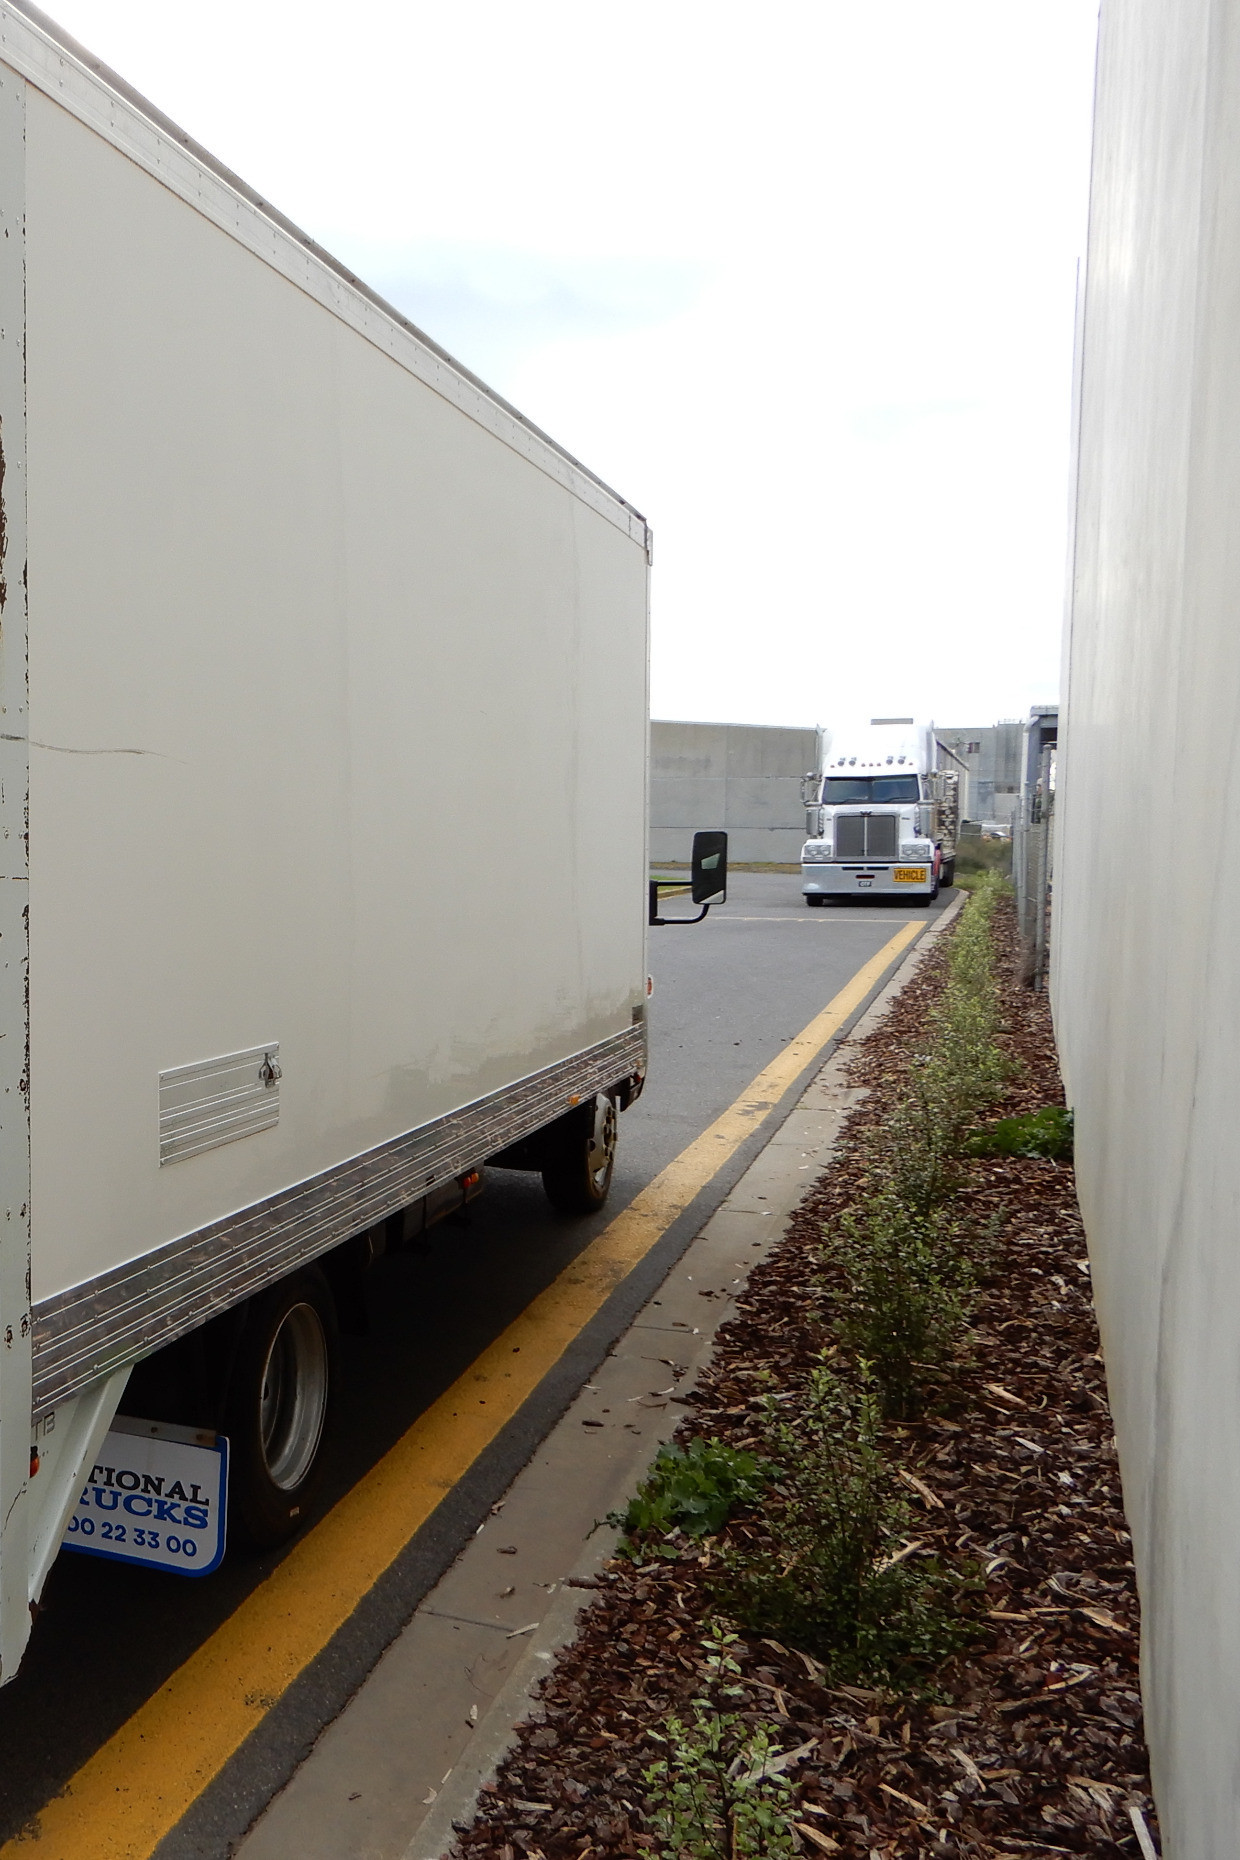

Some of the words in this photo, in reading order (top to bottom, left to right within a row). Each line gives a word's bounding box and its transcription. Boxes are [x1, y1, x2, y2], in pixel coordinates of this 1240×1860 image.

[893, 870, 925, 881] VEHICLE
[31, 1411, 55, 1441] TB
[88, 1465, 210, 1506] TIONAL
[79, 1487, 209, 1530] UCKS
[67, 1515, 95, 1536] 00
[101, 1521, 127, 1543] 22
[133, 1528, 160, 1549] 33
[166, 1535, 197, 1557] 00
